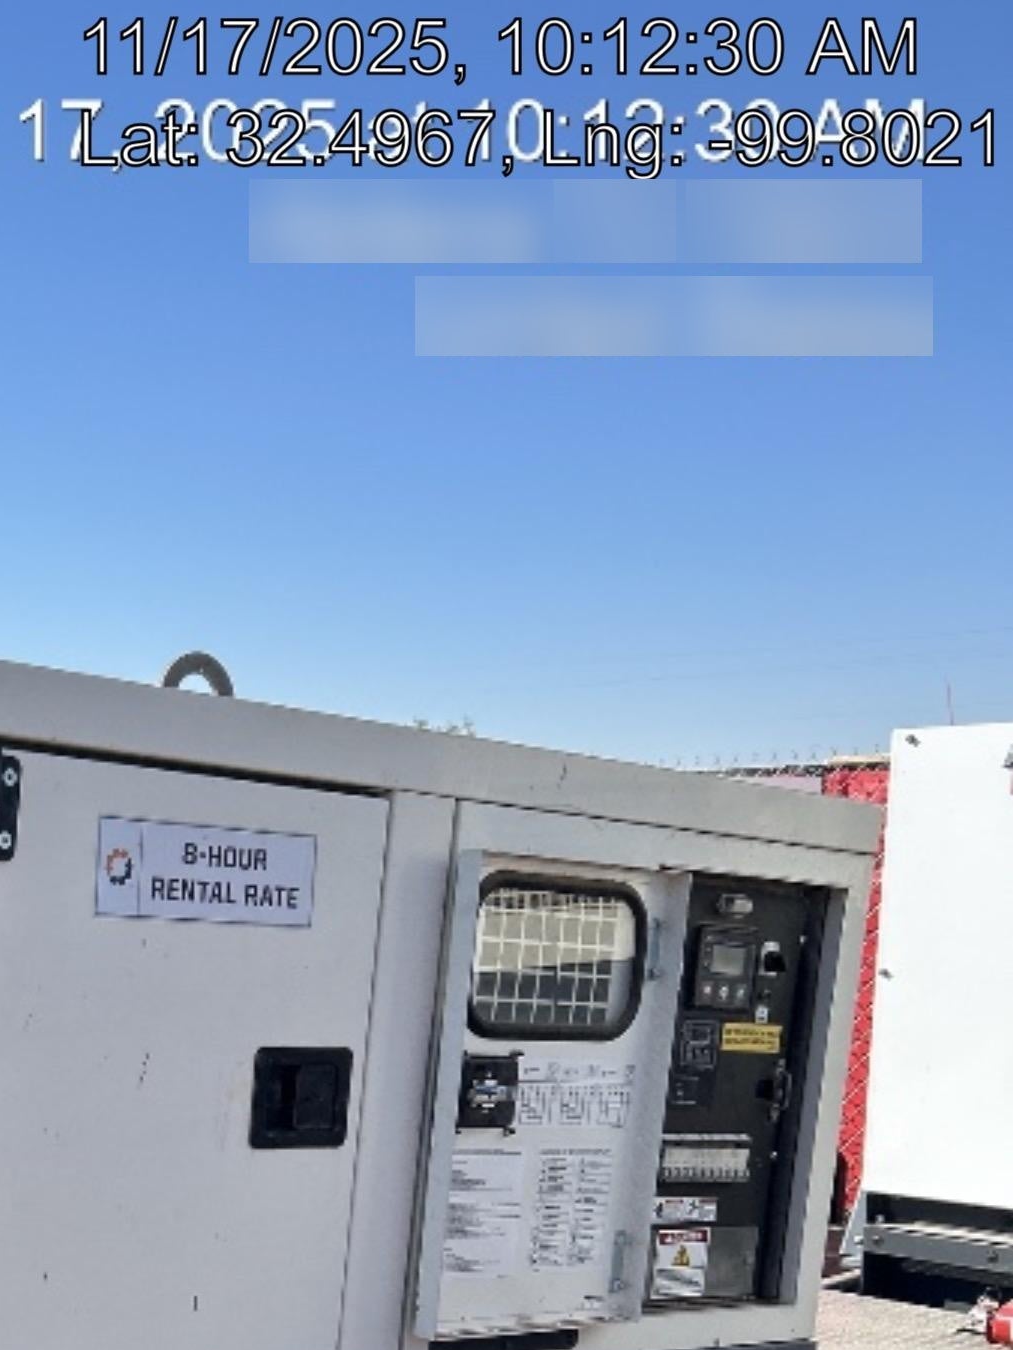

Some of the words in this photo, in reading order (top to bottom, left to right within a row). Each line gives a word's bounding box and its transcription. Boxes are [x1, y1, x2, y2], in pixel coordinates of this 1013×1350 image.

[182, 842, 267, 872] 8-HOUR
[150, 876, 238, 905] RENTAL
[243, 884, 300, 910] RATE
